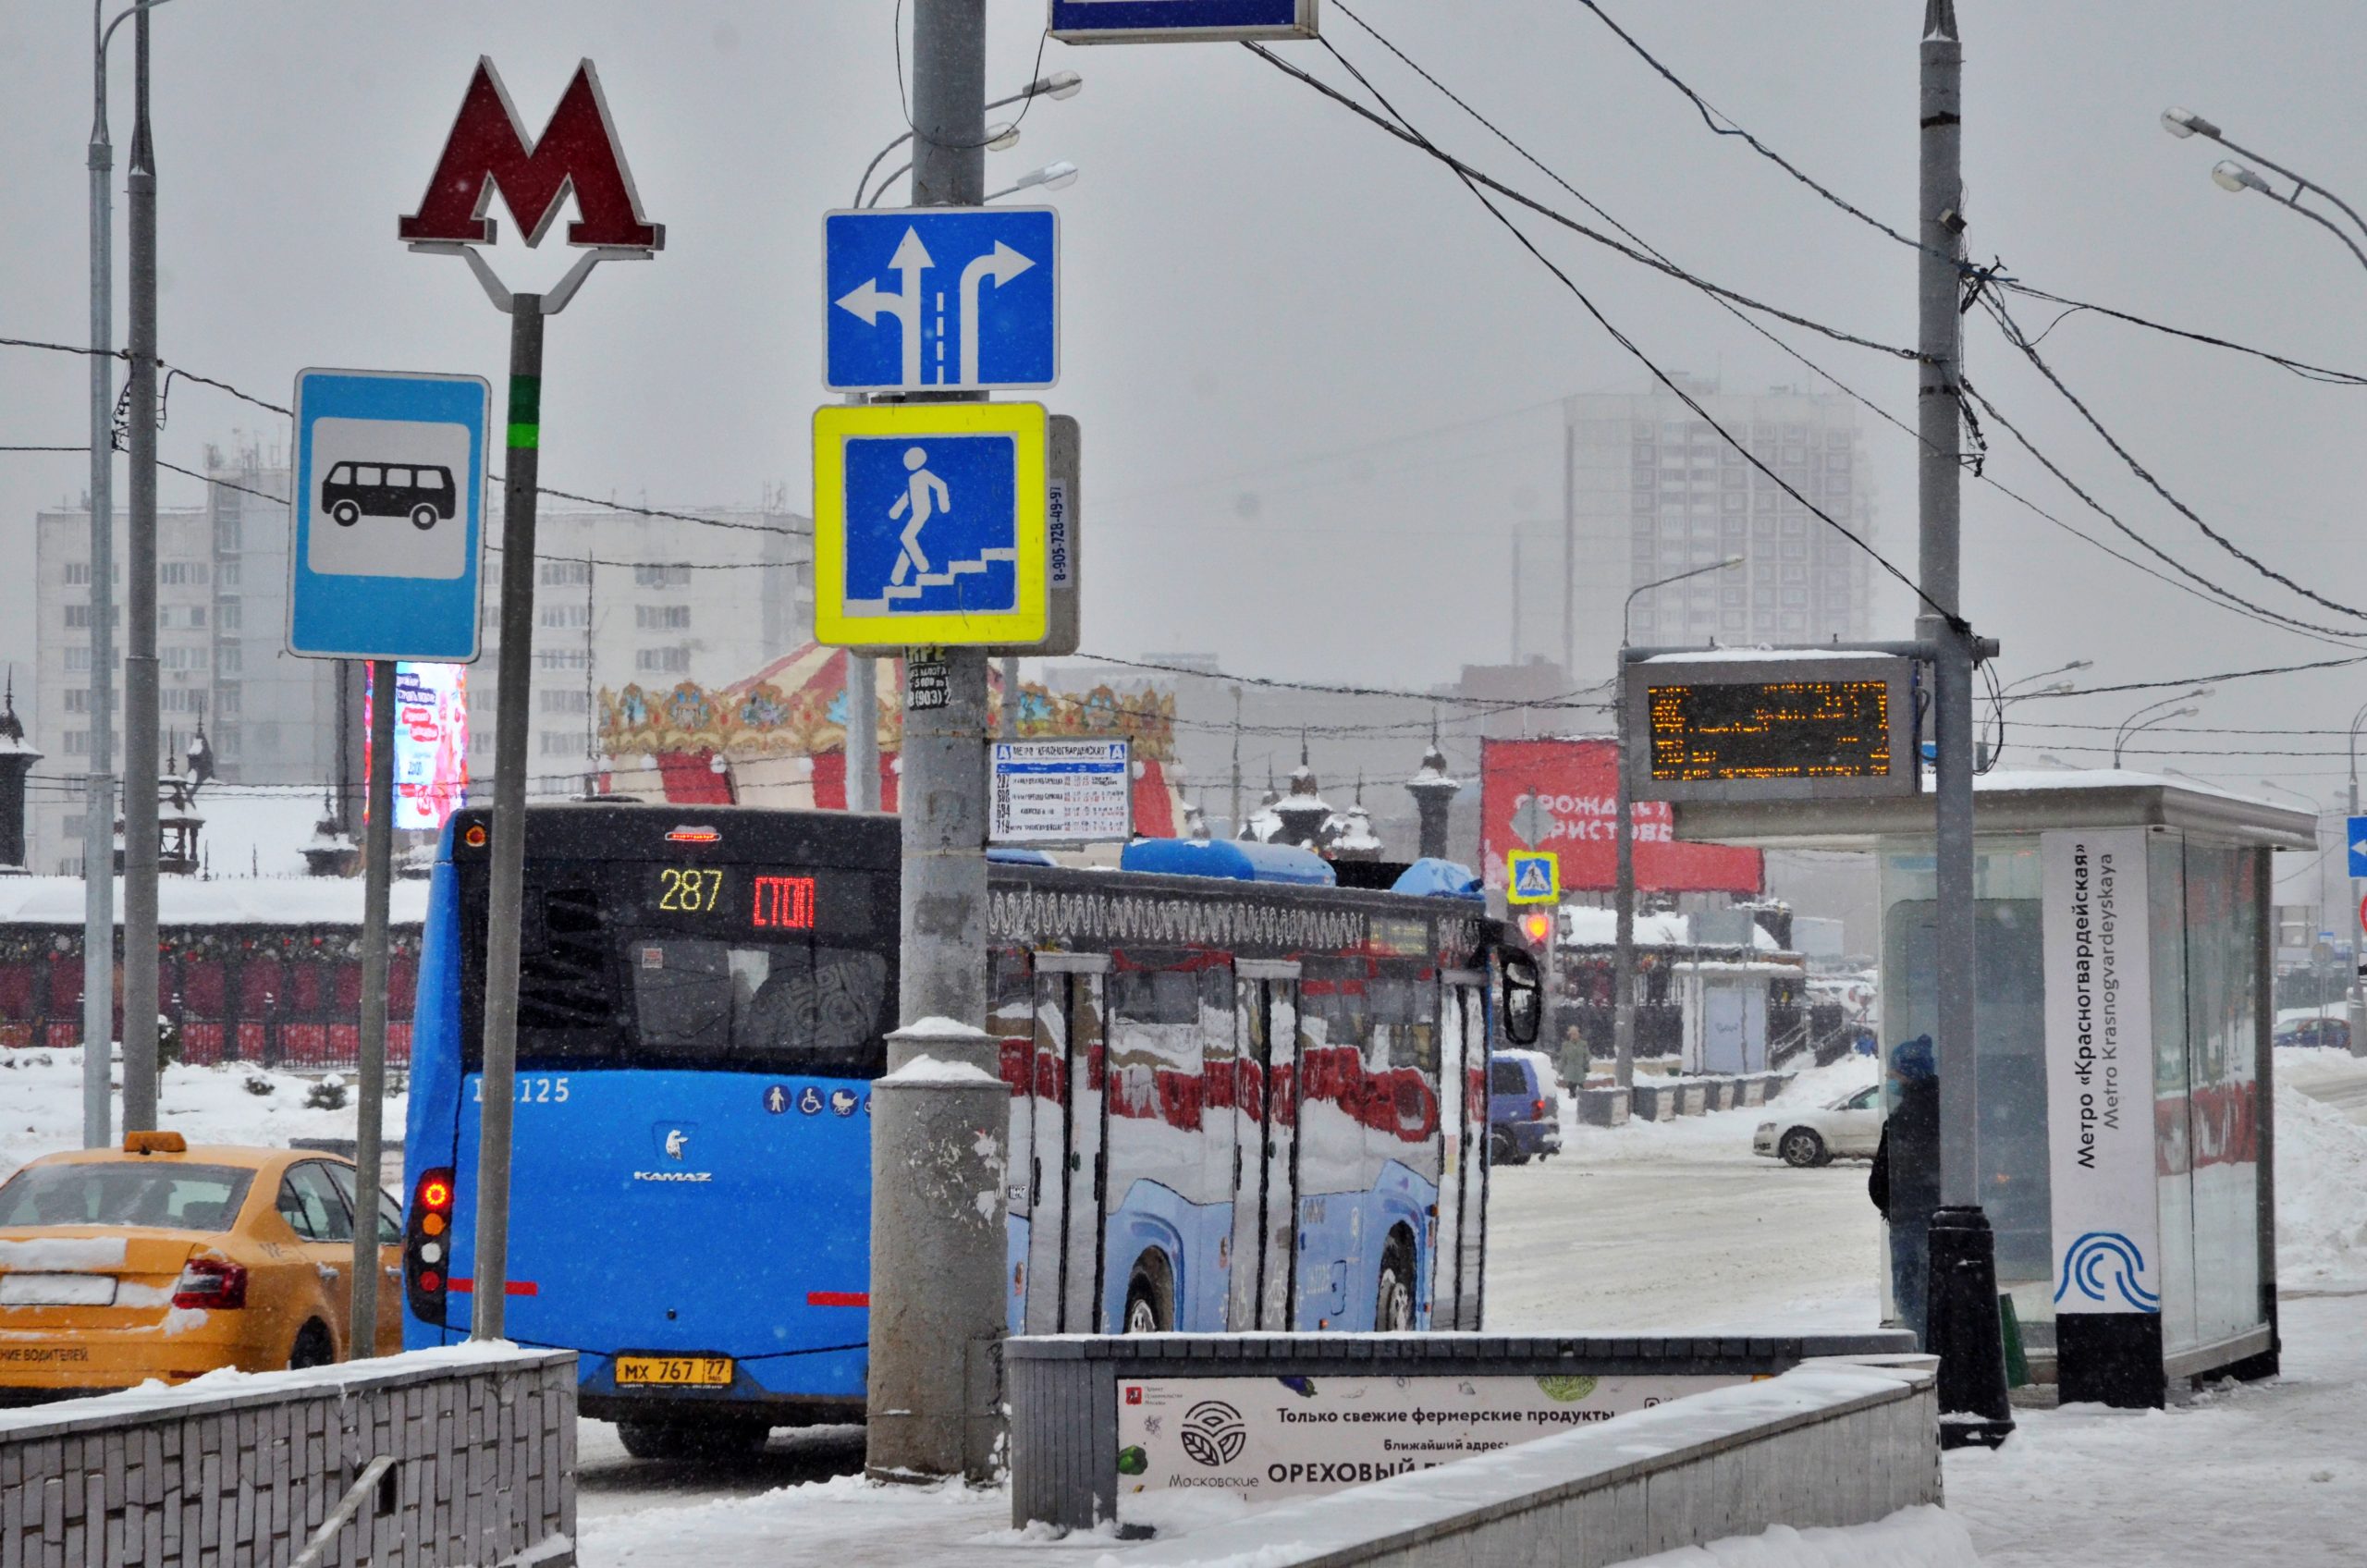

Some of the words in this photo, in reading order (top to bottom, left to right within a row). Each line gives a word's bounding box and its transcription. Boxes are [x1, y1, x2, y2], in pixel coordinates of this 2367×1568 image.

[398, 54, 665, 250] М
[659, 869, 723, 912] 287
[753, 876, 815, 928] СТОП
[2071, 843, 2097, 1085] «Красногвардейская»
[2098, 853, 2120, 1063] Krasnogvardeyskaya
[2103, 1066, 2119, 1130] Metro
[2078, 1093, 2098, 1170] Метро
[633, 1170, 713, 1182] KAMAZ
[658, 1361, 694, 1380] 767
[705, 1360, 726, 1376] 77
[1277, 1407, 1339, 1424] Только
[1343, 1411, 1408, 1424] свежие
[1411, 1407, 1522, 1426] фермерские
[1527, 1410, 1615, 1425] продукты
[1383, 1439, 1464, 1452] Ближайший
[1169, 1474, 1259, 1488] Московские
